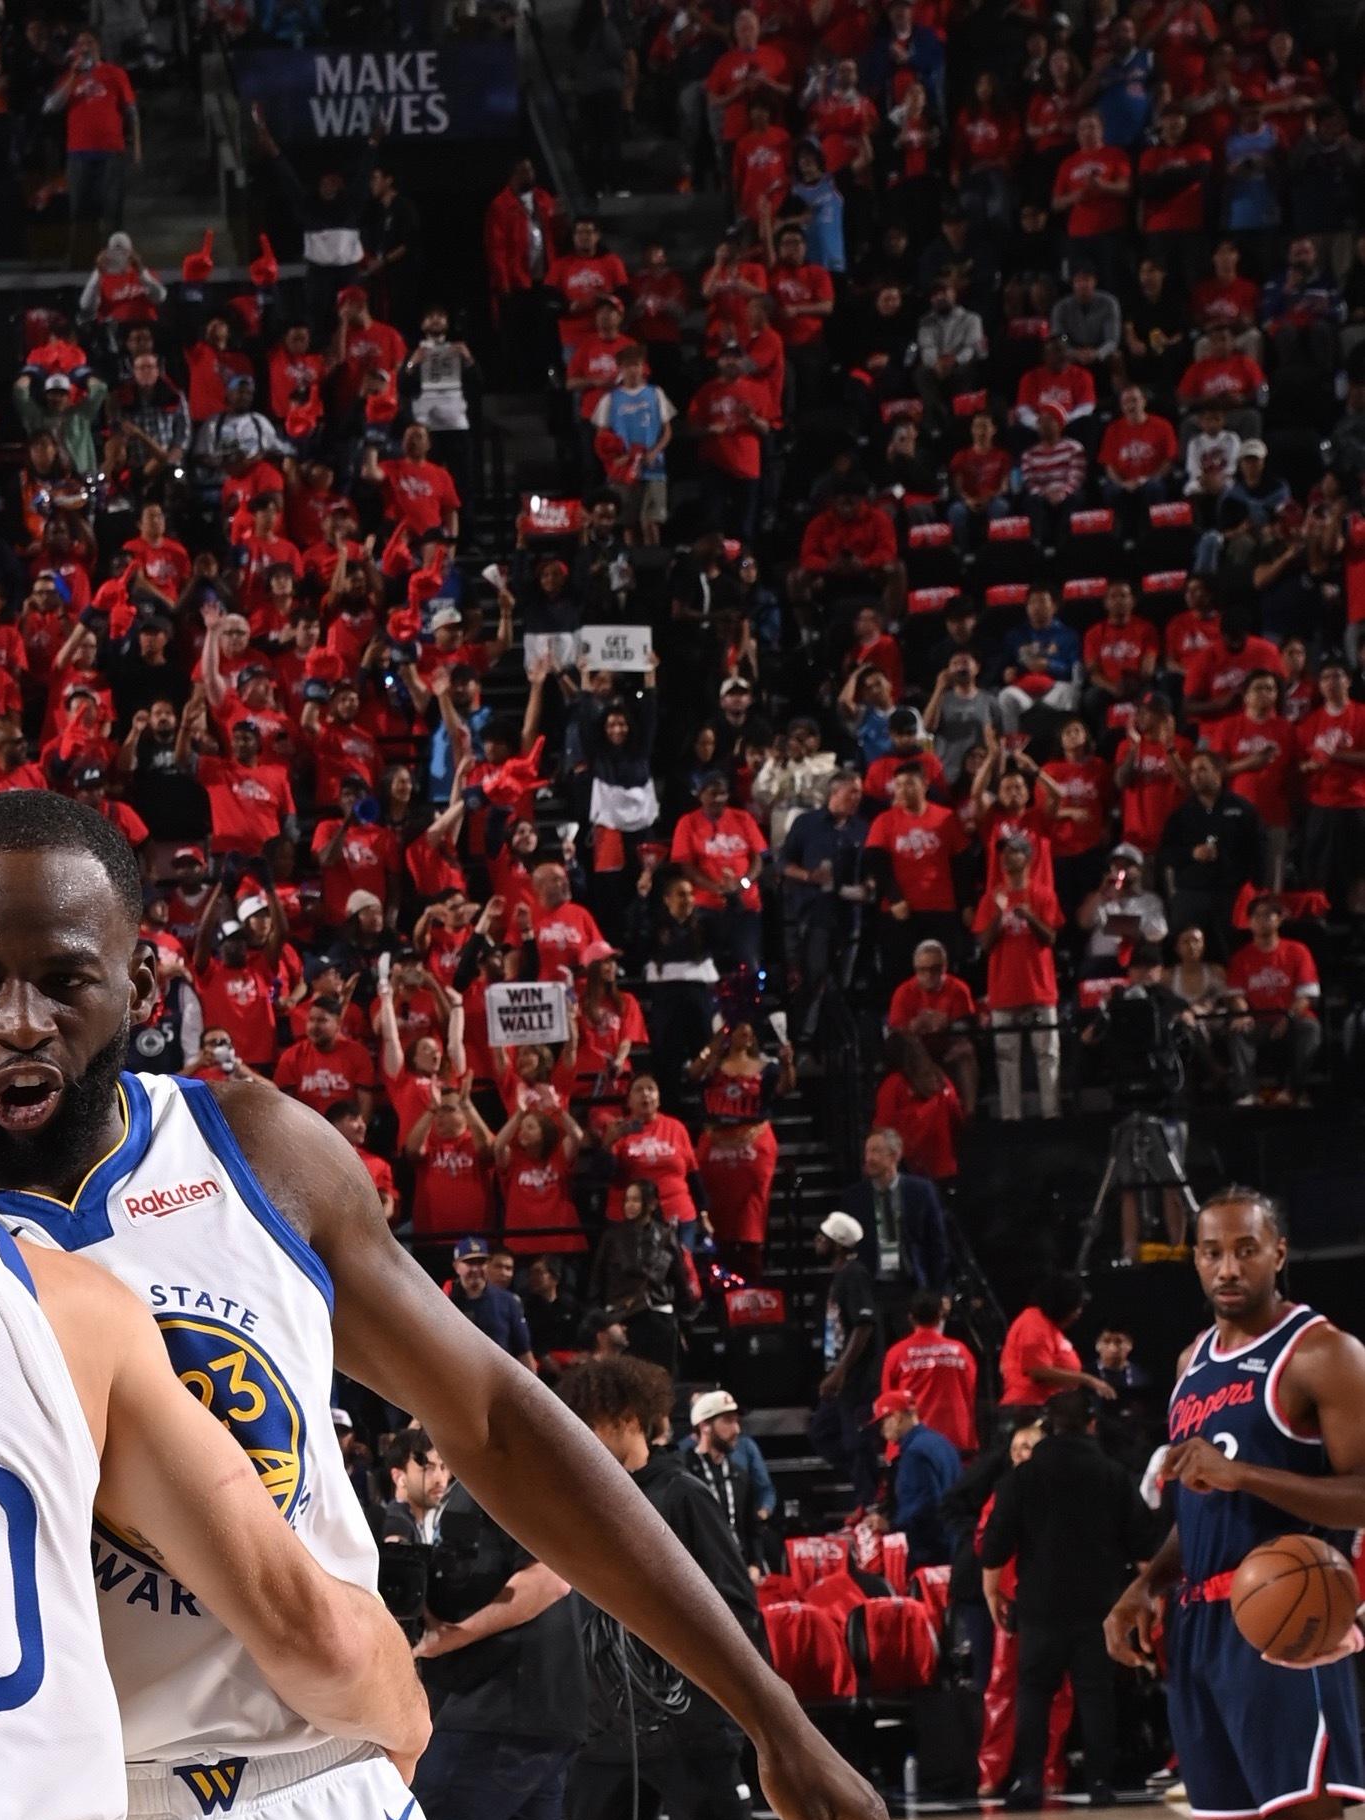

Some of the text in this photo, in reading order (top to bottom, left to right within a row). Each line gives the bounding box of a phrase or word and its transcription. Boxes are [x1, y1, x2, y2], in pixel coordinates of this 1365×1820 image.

[315, 52, 440, 95] MAKE
[310, 93, 450, 138] WAVES
[506, 987, 543, 1003] WIN
[499, 1013, 554, 1032] WALL!
[125, 1178, 220, 1218] Rakuten
[150, 1285, 259, 1333] STATE
[1169, 1380, 1255, 1440] Clippers
